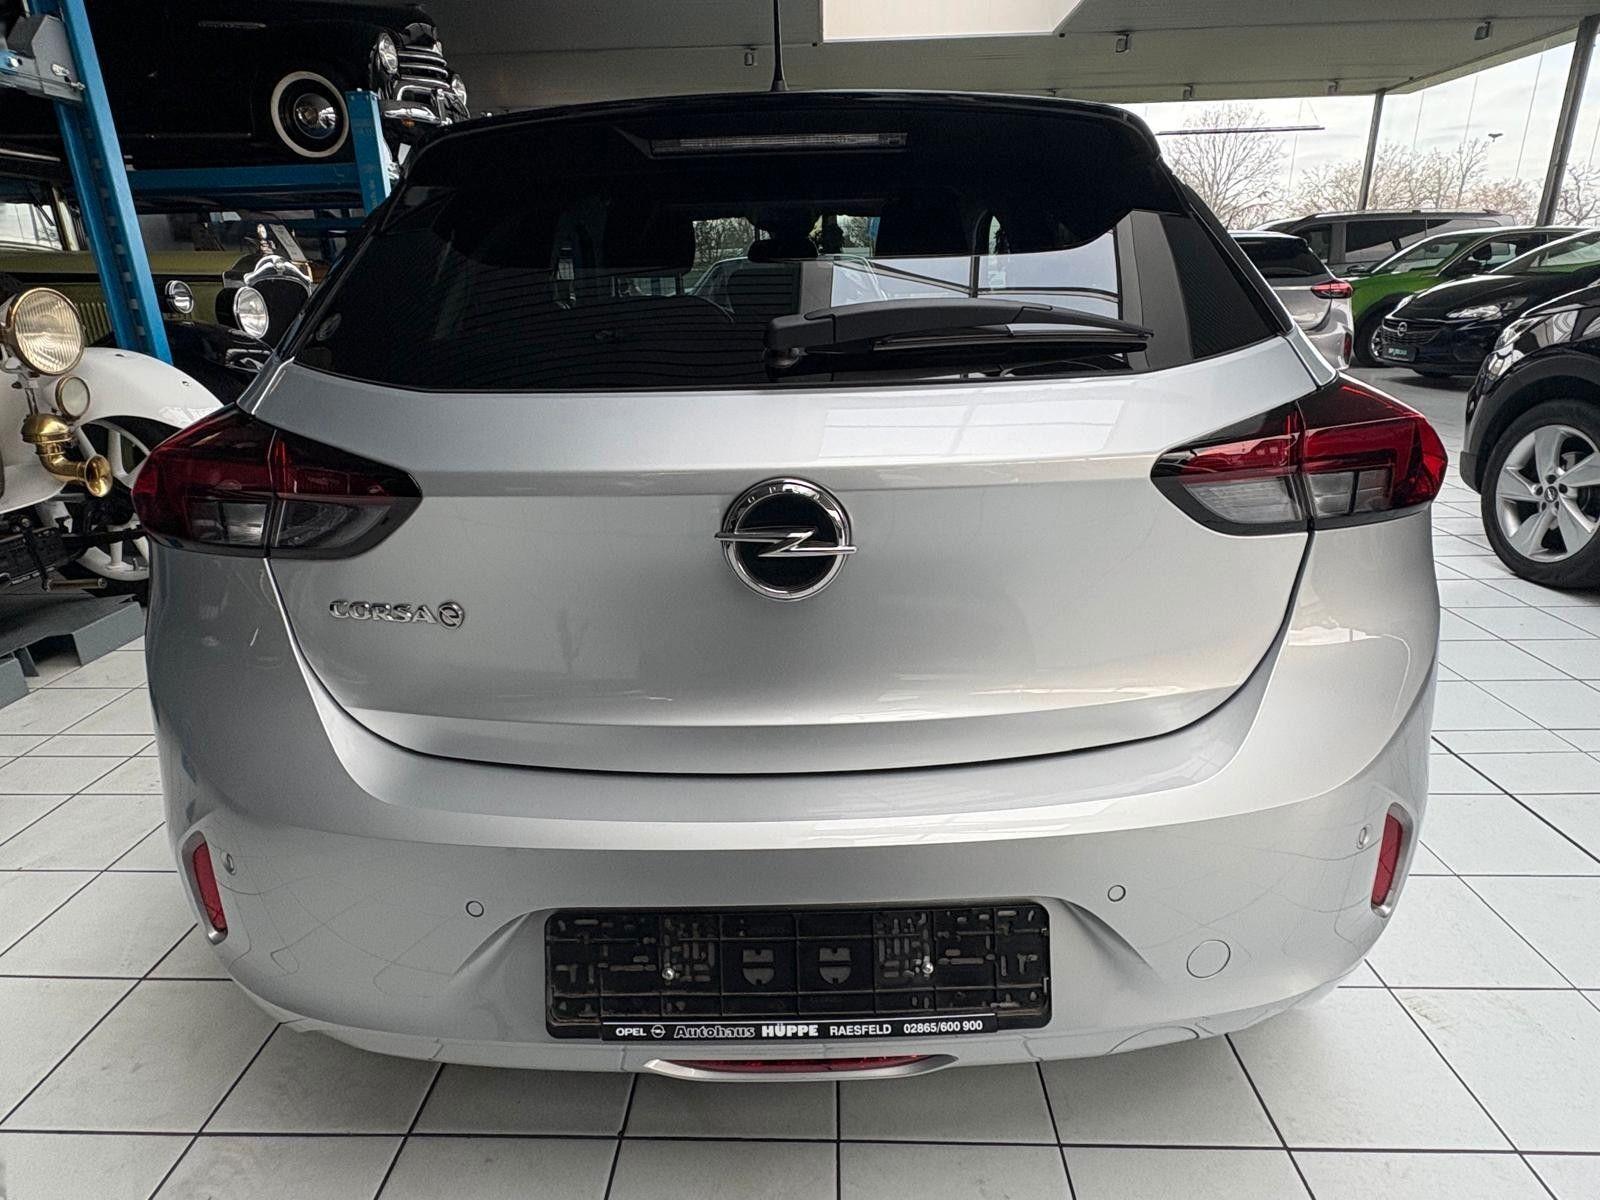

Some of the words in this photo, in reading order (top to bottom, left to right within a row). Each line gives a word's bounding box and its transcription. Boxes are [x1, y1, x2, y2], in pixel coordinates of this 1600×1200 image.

[615, 1027, 647, 1037] OPEL
[674, 1025, 756, 1039] Autohaus
[761, 1023, 819, 1037] HÜPPE
[829, 1024, 892, 1036] RAESFELD
[903, 1021, 961, 1034] 02865/600
[962, 1020, 983, 1031] 900
